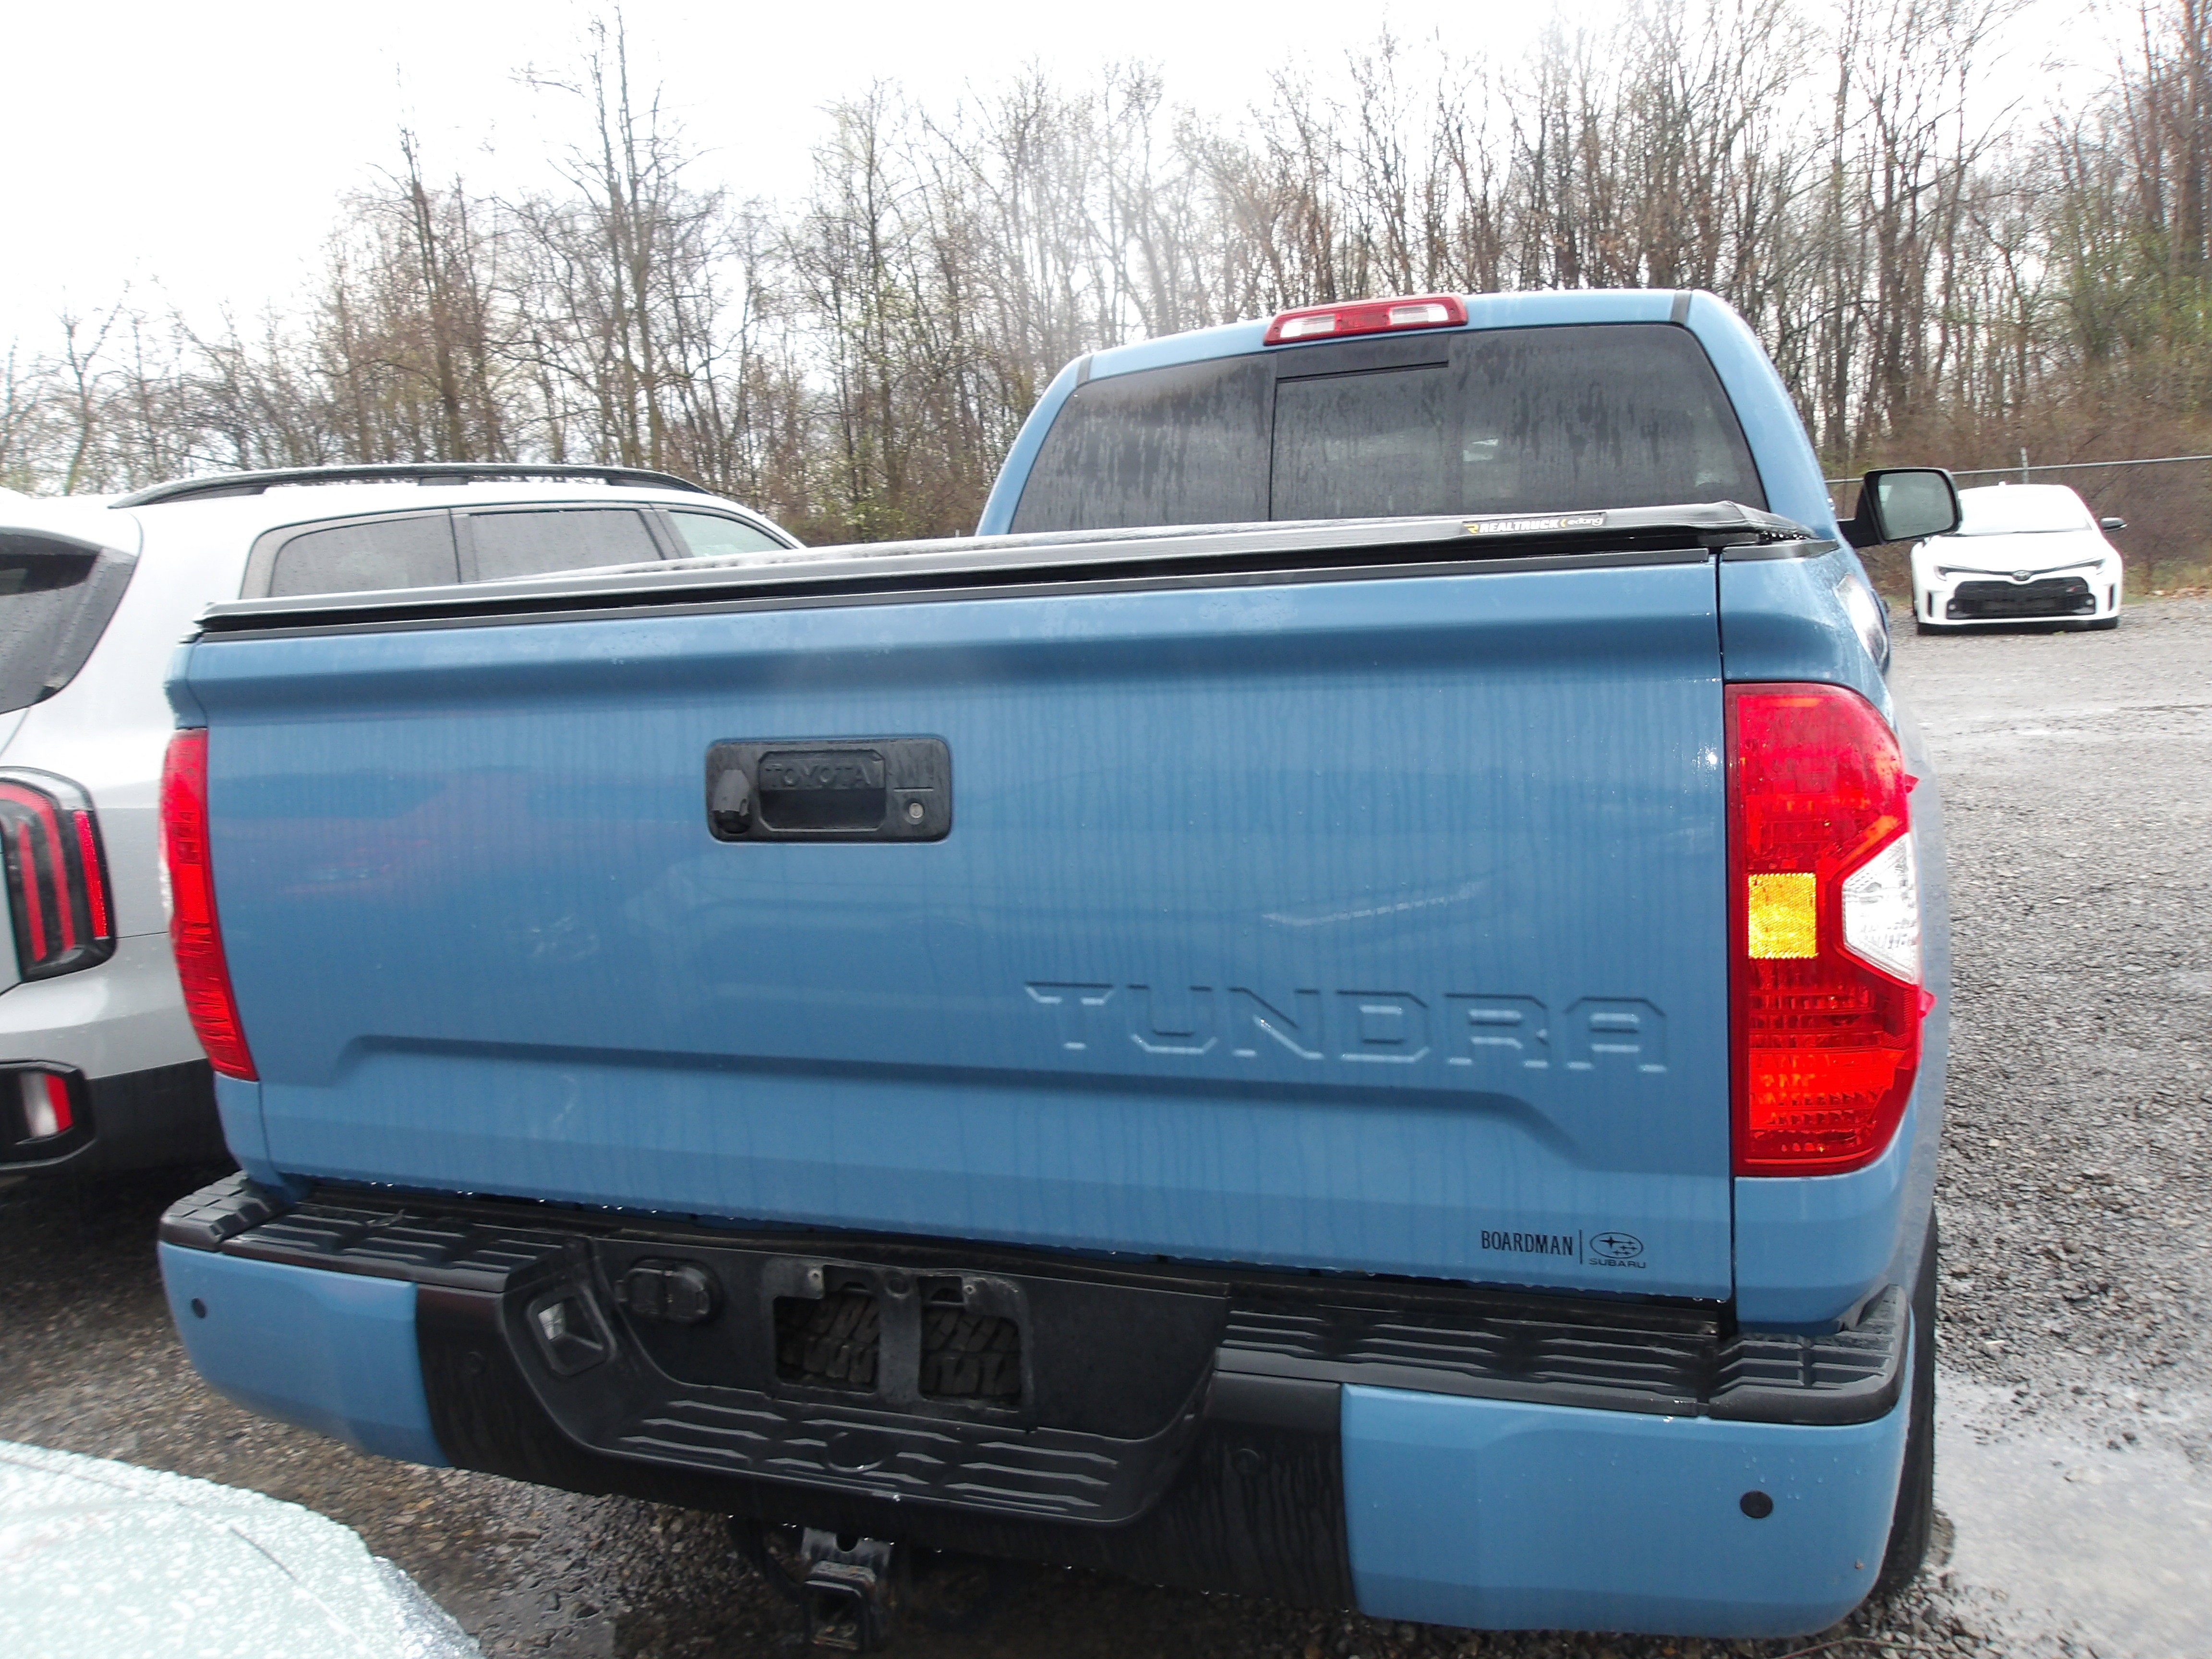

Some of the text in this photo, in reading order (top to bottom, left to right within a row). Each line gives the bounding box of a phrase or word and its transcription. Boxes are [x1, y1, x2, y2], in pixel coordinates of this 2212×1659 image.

[1479, 519, 1559, 533] REALTRUCK
[765, 764, 871, 787] TOYOTA
[1024, 981, 1668, 1073] TUNDRA
[1481, 1230, 1574, 1256] BOARDMAN
[1589, 1258, 1646, 1269] SUBARU
